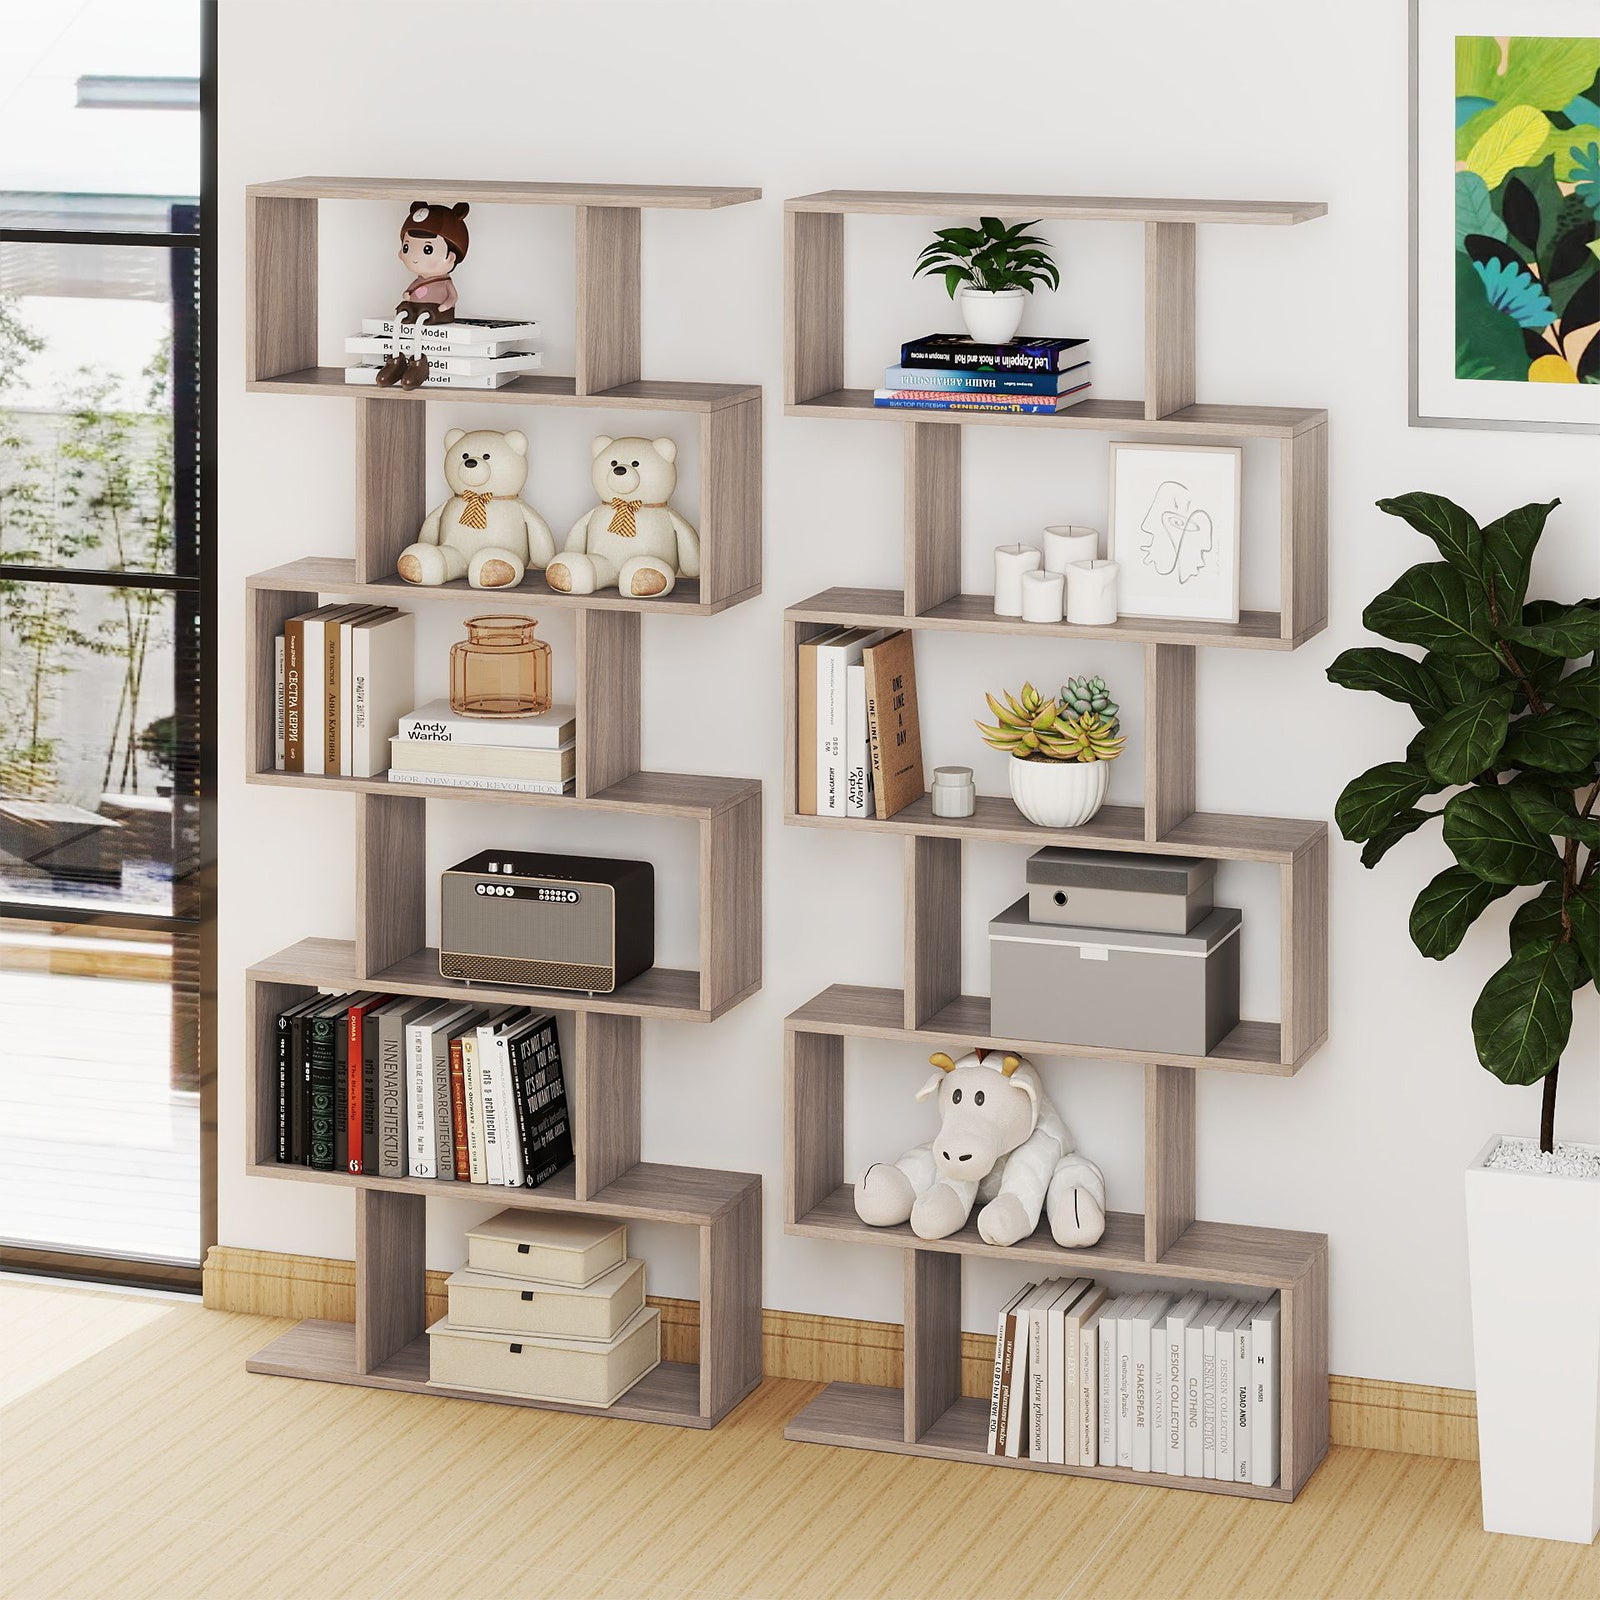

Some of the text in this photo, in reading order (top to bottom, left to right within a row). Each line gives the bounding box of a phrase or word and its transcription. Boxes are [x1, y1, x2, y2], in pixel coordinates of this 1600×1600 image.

[428, 360, 448, 370] odel
[954, 354, 1049, 370] Led Zeppelin in Rock and Roll
[901, 374, 996, 388] НАШИ АВИАНОСЦЫ
[288, 670, 298, 707] СЕСТРА
[892, 674, 903, 692] ONE
[893, 692, 905, 711] LINE
[288, 711, 298, 742] КЕРРИ
[413, 722, 446, 734] Andy
[899, 713, 903, 727] A
[408, 731, 452, 742] Warhol
[825, 741, 830, 752] WS
[897, 729, 906, 746] DAY
[425, 776, 450, 786] NEW
[452, 778, 483, 788] LOOK
[486, 781, 558, 793] REVOLUTION
[848, 771, 857, 803] Andy
[521, 1039, 530, 1060] IT'S
[536, 1049, 547, 1069] YOU
[483, 1070, 492, 1085] arts
[525, 1076, 535, 1097] IT'S
[365, 1087, 375, 1135] architecture
[384, 1039, 398, 1167] INNENARCHITEKTUR
[527, 1094, 538, 1114] YOU
[436, 1056, 452, 1171] INNENARCHITEKTUR
[484, 1098, 496, 1144] architecture
[1120, 1355, 1129, 1392] Constructing
[1156, 1372, 1161, 1385] MY
[1170, 1344, 1179, 1449] DESIGN COLLECTION
[1189, 1378, 1198, 1428] CLOTHING
[1204, 1354, 1214, 1451] DESIGN COLLECTION
[1220, 1359, 1228, 1454] DESIGN COLLECTION
